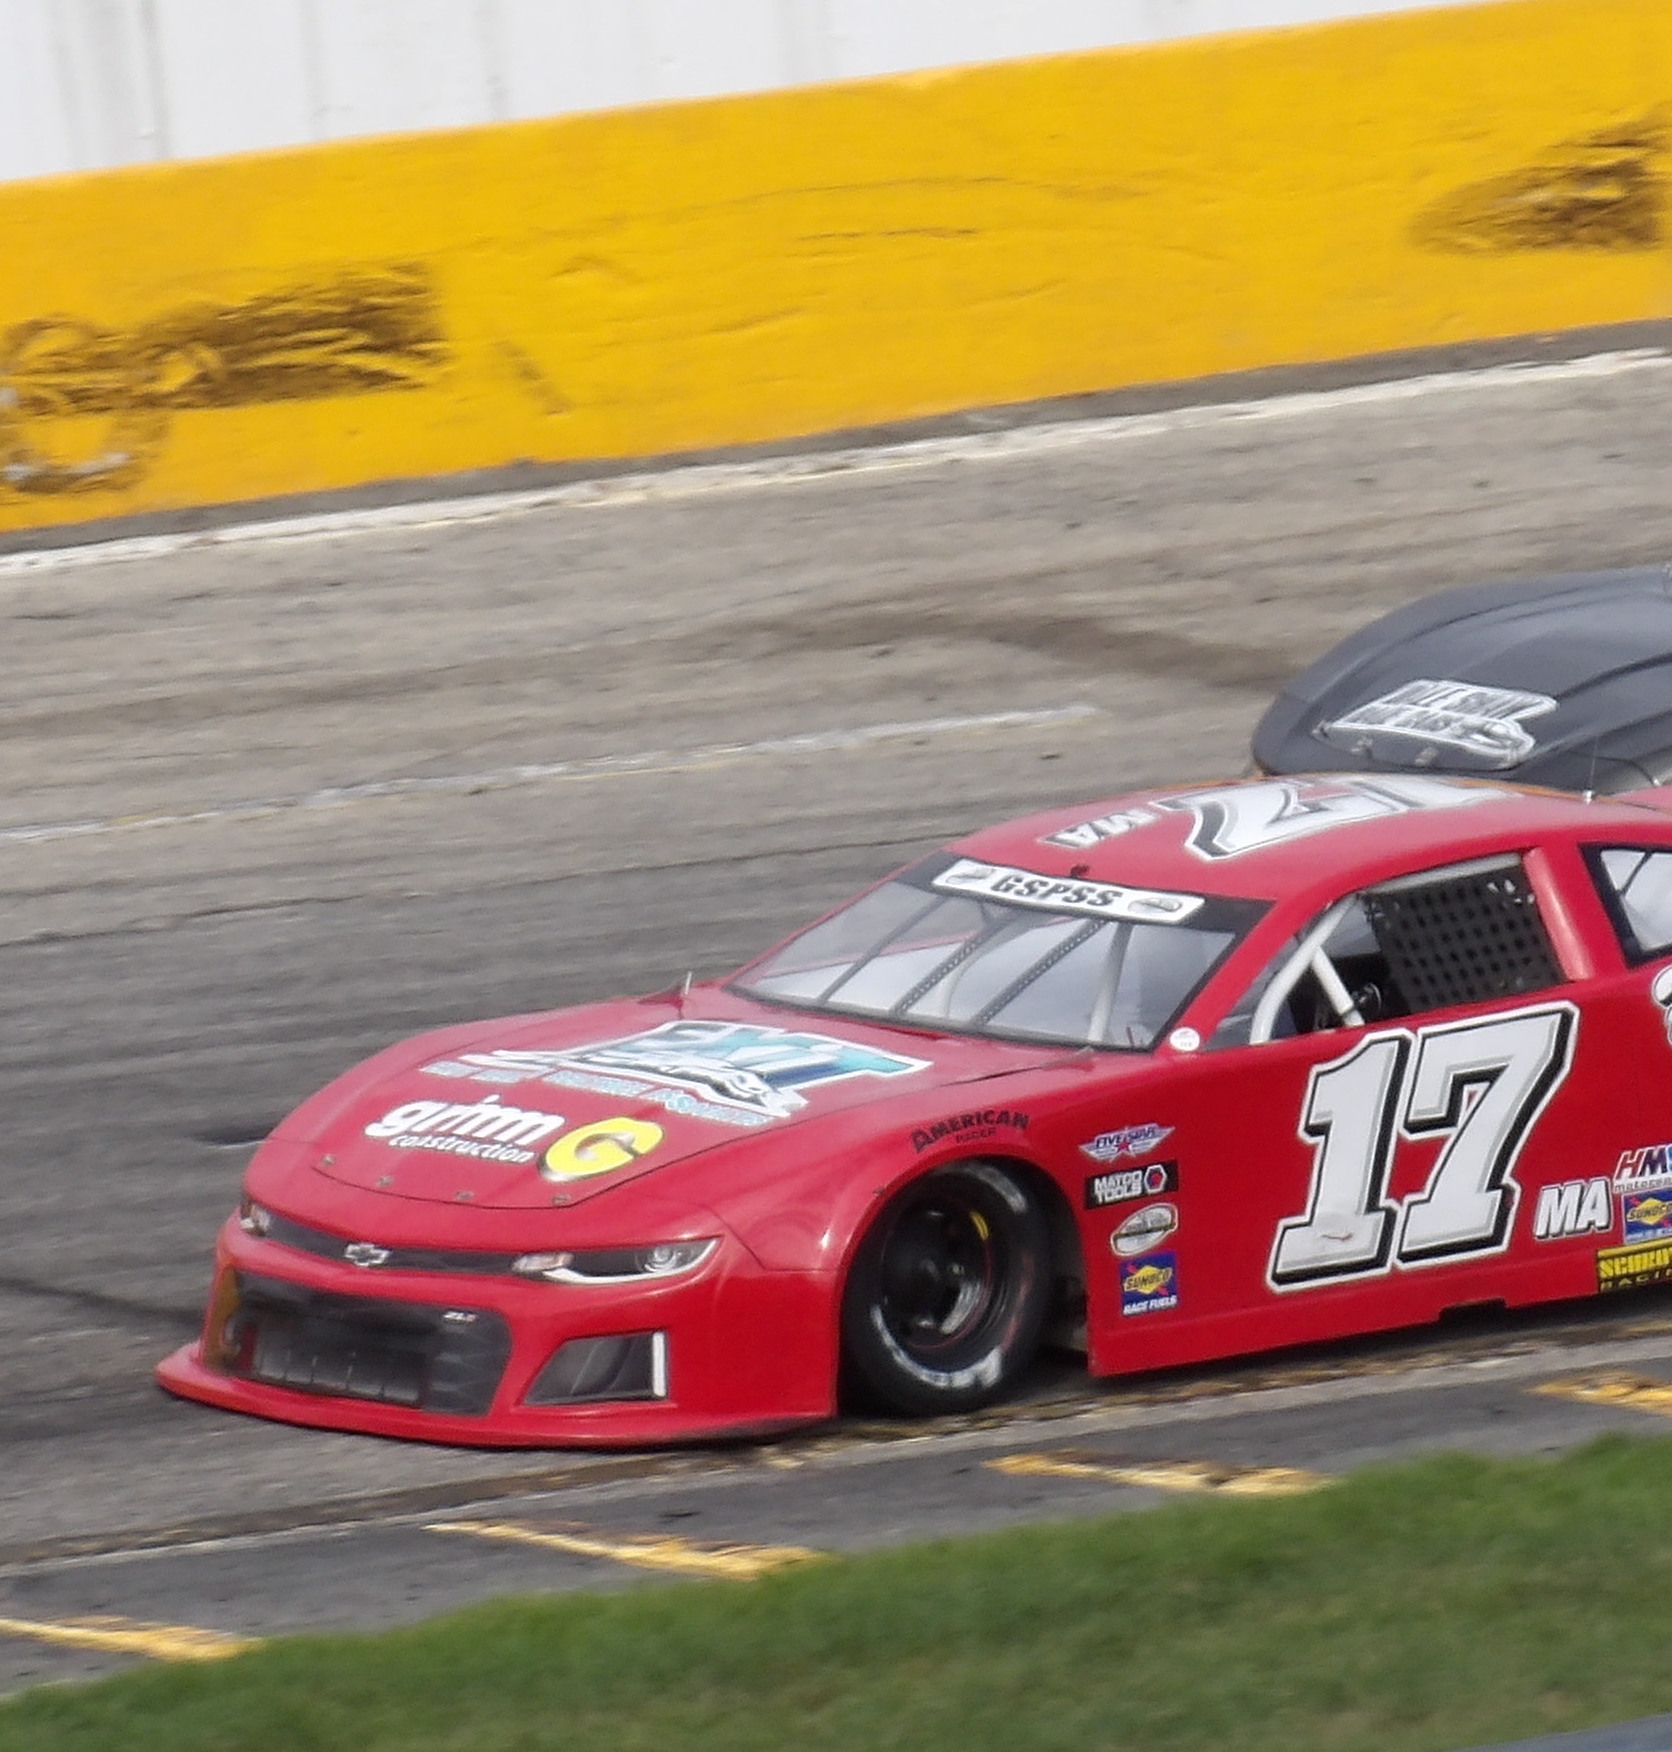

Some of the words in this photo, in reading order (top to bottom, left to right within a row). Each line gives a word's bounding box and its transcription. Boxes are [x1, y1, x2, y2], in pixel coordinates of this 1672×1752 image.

[990, 875, 1123, 907] GSPSS
[911, 1109, 1030, 1154] AMERICAN
[1267, 1001, 1580, 1293] 17
[388, 1134, 537, 1164] construction
[1094, 1170, 1142, 1194] MATCO
[1096, 1183, 1142, 1204] TOOLS
[1534, 1177, 1613, 1241] MA
[1125, 1268, 1172, 1290] SUNOCO
